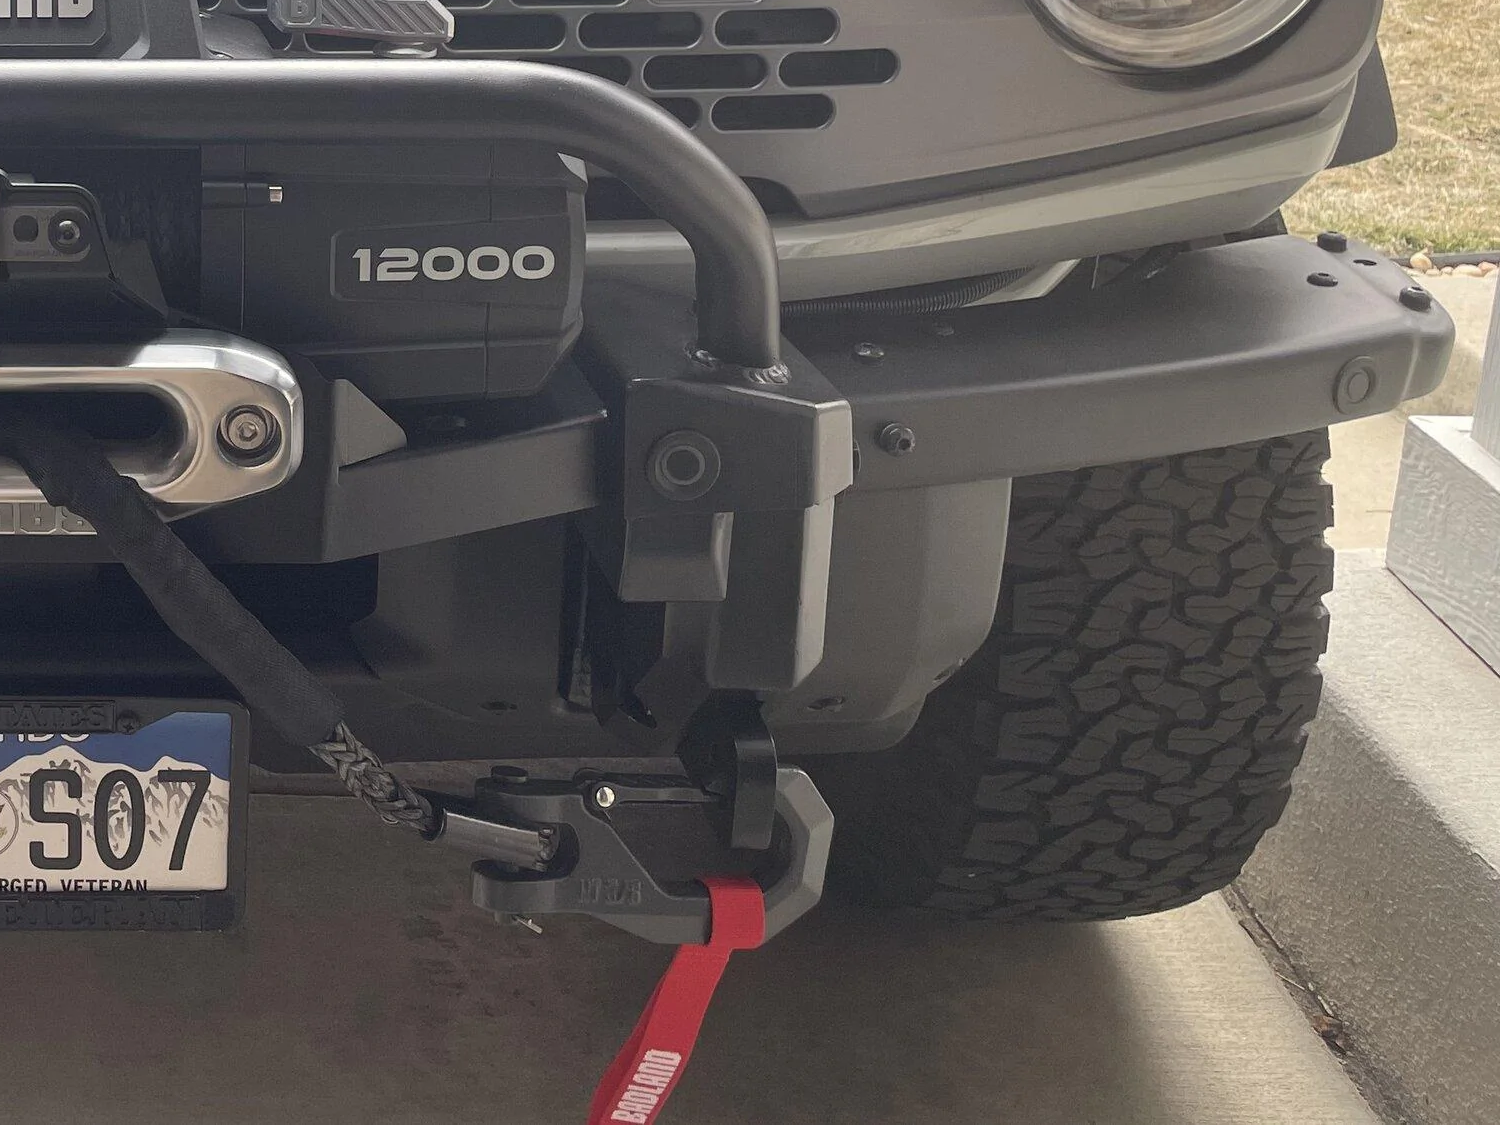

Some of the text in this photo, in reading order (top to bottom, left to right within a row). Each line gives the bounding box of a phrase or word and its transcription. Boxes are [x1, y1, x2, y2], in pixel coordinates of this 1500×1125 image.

[352, 245, 556, 282] 12000
[60, 879, 149, 893] VETERAN
[610, 1048, 682, 1125] BADLAND
